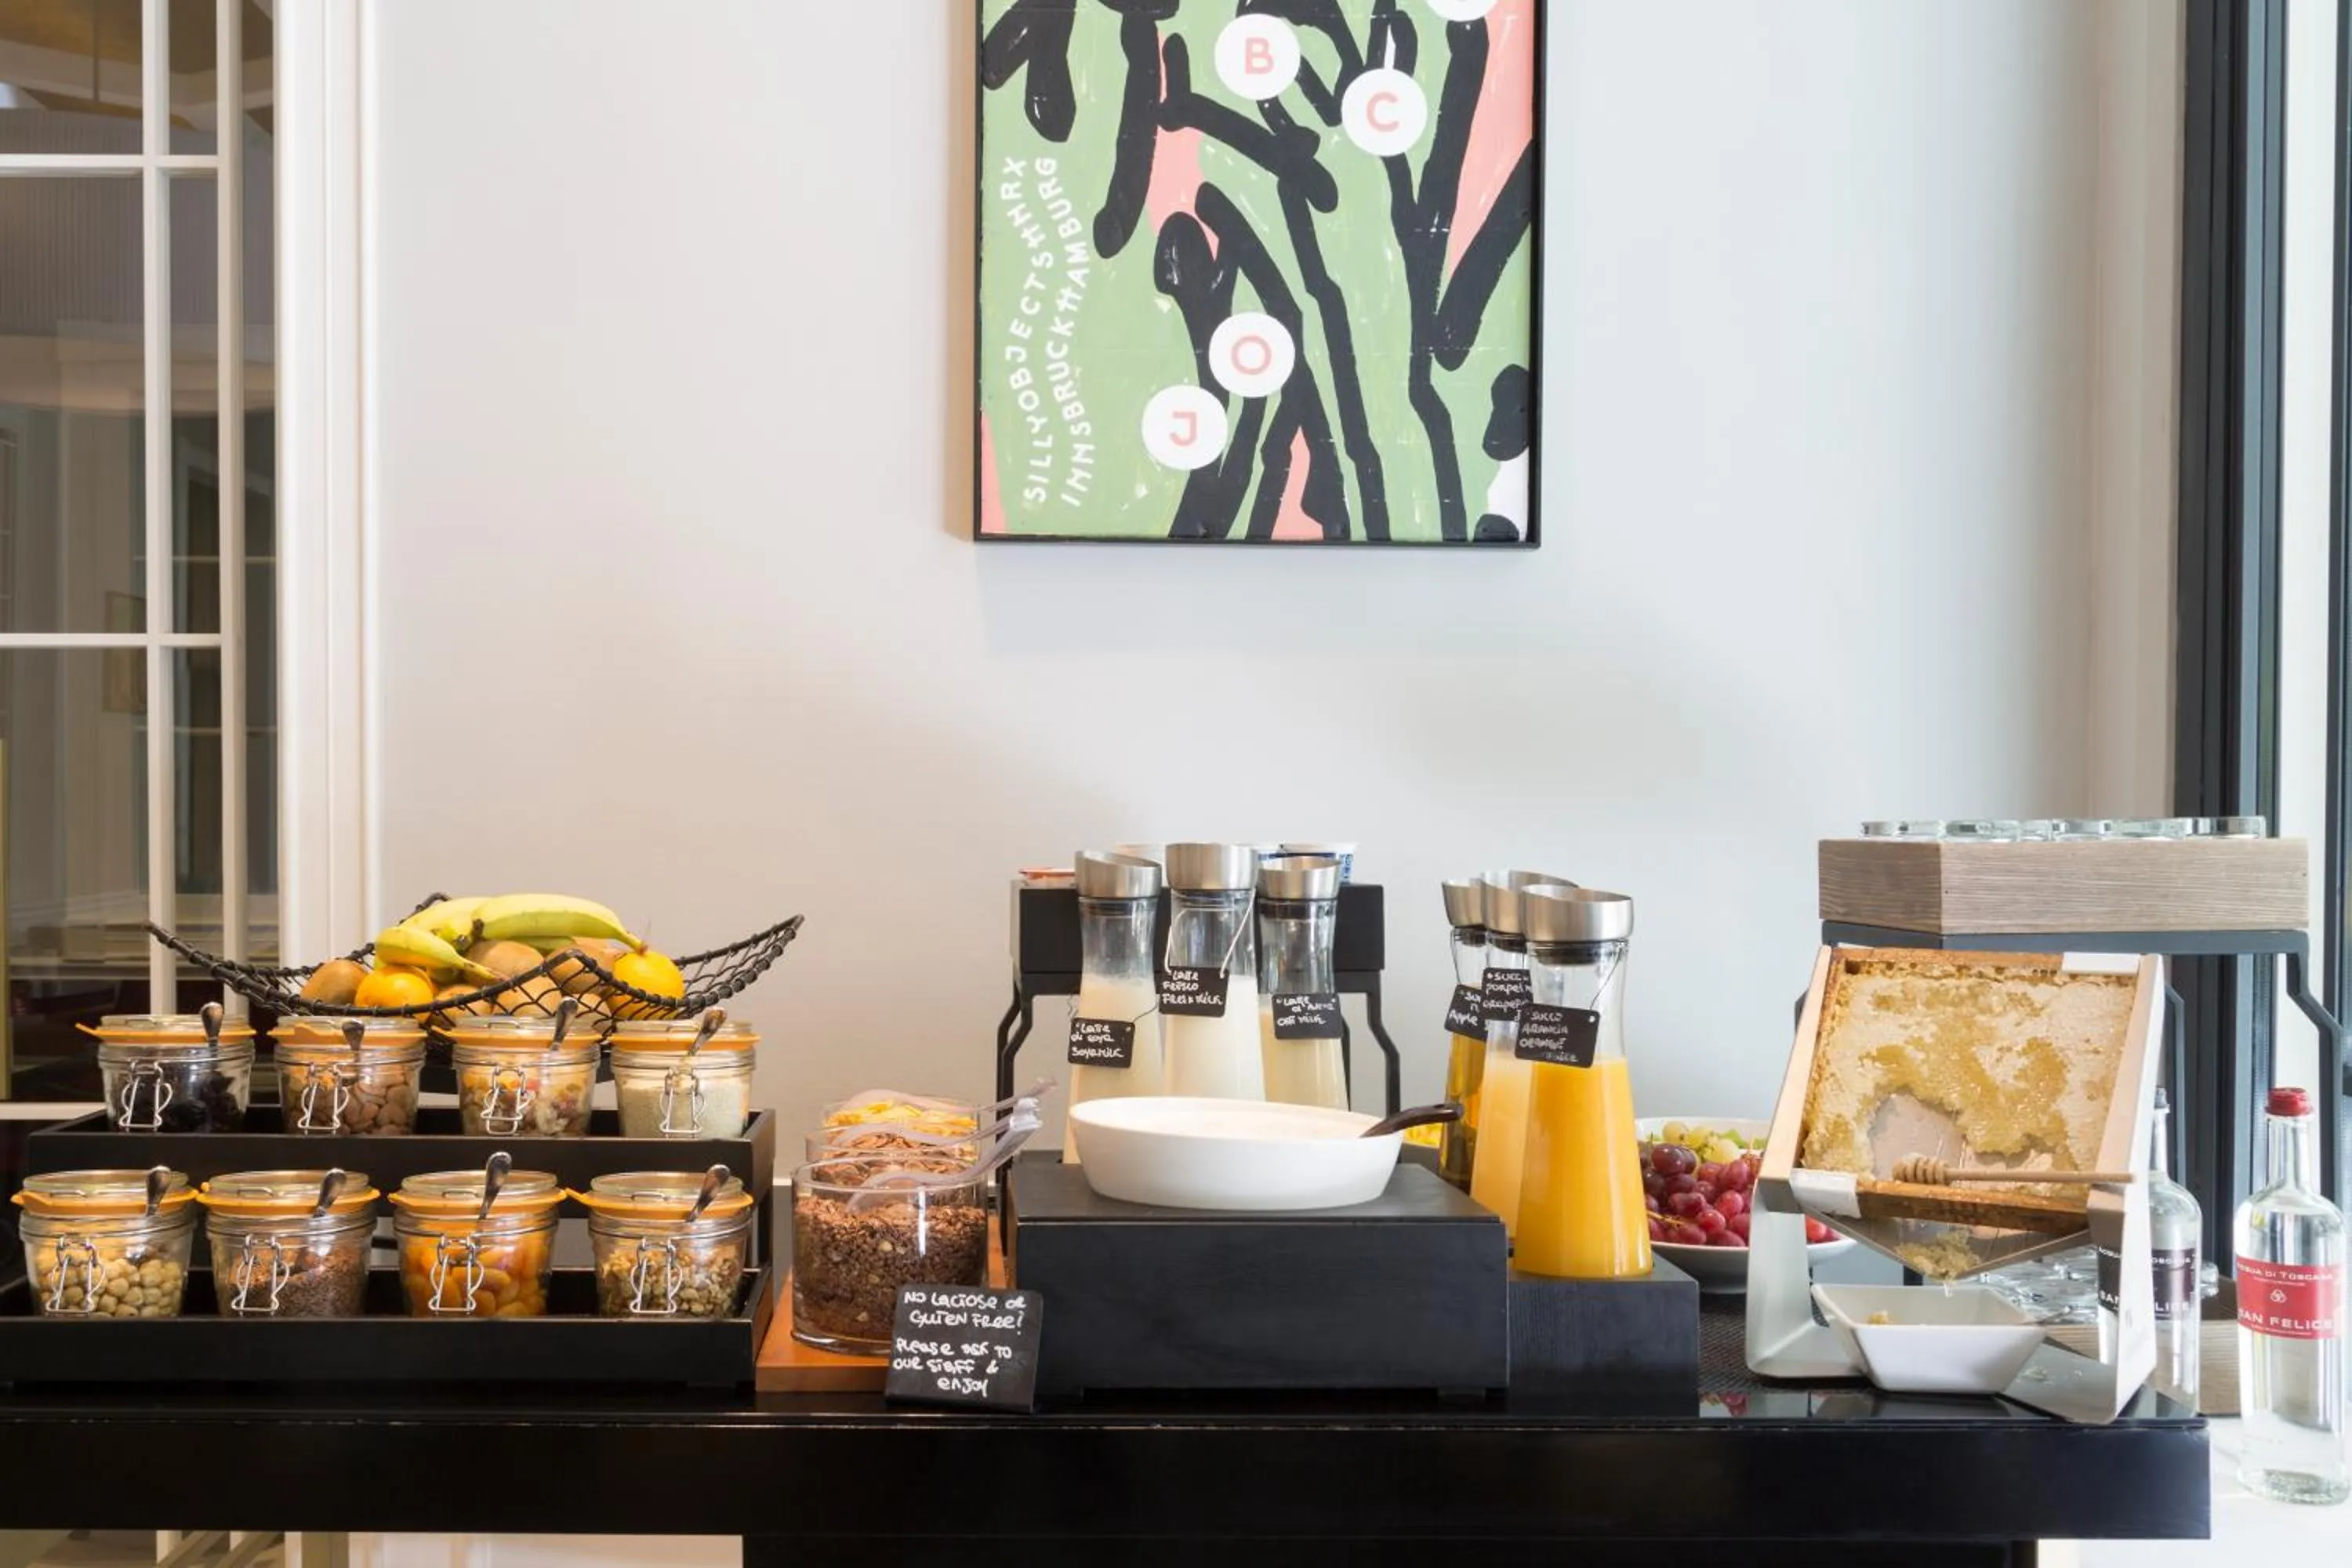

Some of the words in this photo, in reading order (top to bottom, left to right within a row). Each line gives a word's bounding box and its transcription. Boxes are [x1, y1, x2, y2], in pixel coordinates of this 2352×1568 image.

[1244, 37, 1275, 75] B
[1366, 91, 1400, 132] C
[1231, 335, 1272, 376] O
[1169, 411, 1198, 447] J
[2269, 1316, 2334, 1330] FELICE
